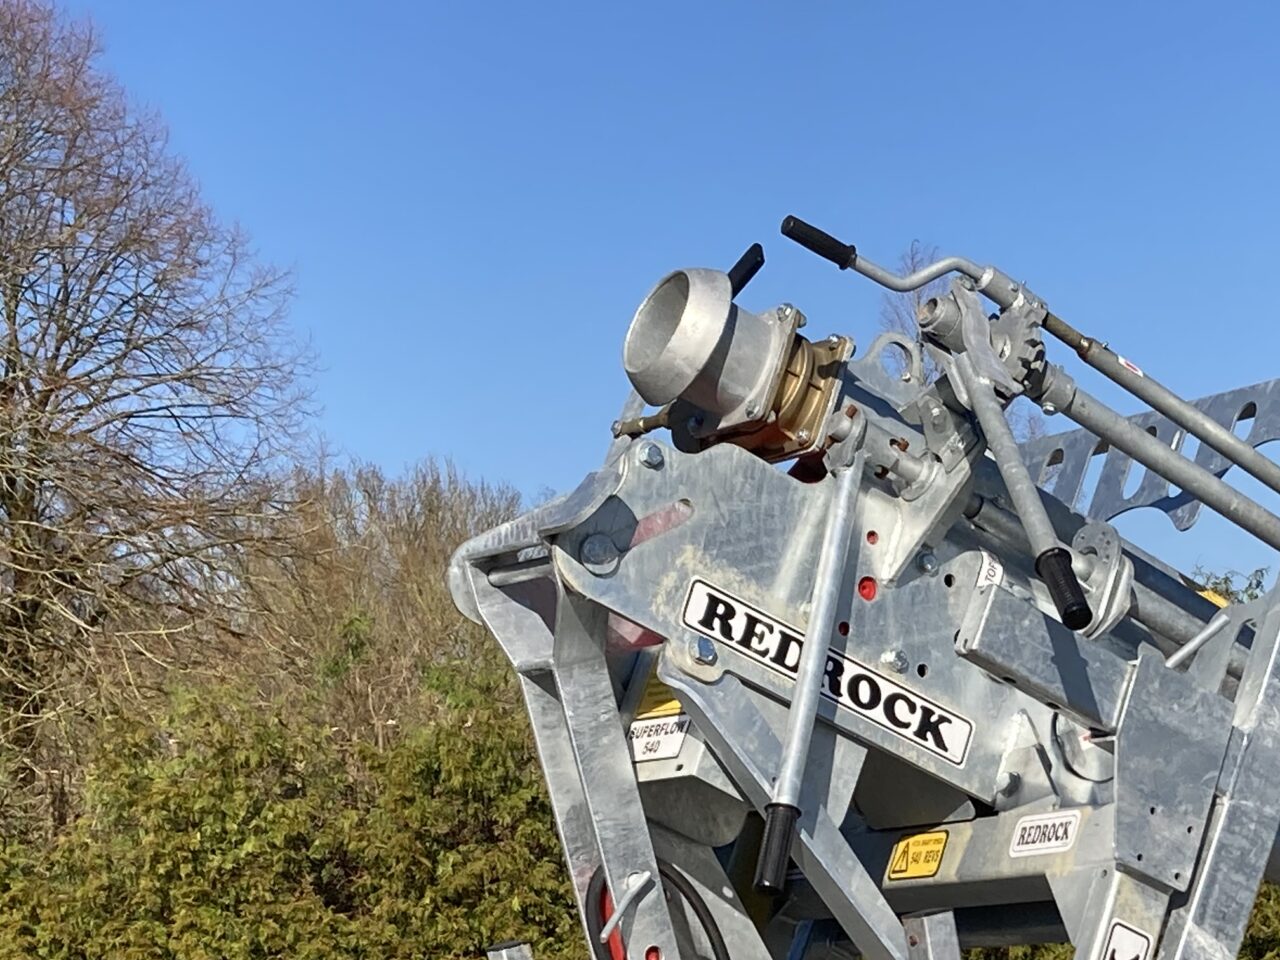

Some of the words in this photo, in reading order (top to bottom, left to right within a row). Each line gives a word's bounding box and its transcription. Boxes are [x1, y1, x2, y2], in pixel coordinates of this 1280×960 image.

[698, 592, 952, 754] REDROCK
[629, 720, 687, 740] SUPERFLOW
[642, 740, 661, 755] 540
[1016, 821, 1072, 846] REDROCK
